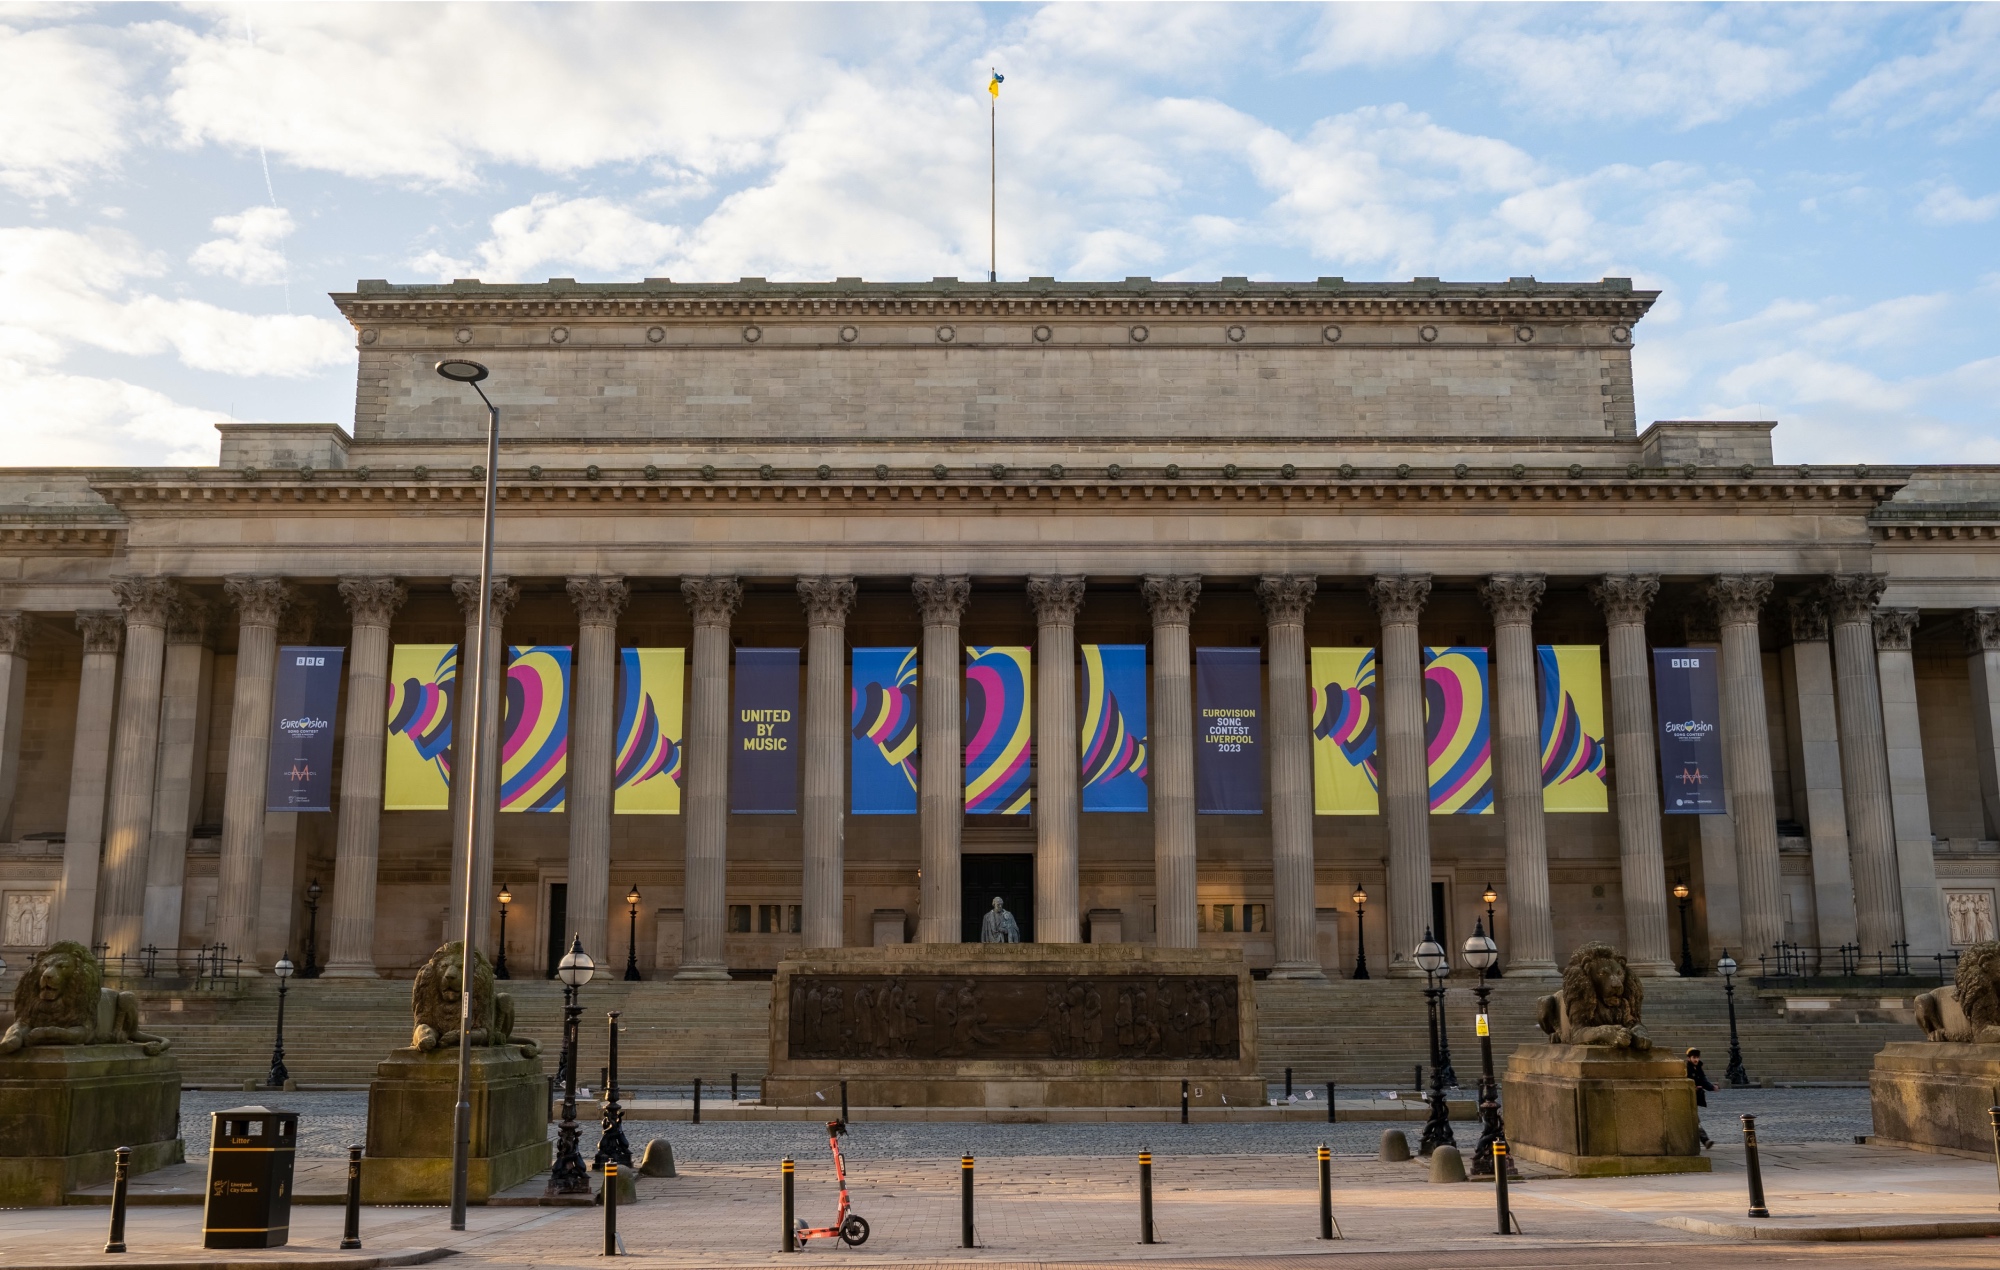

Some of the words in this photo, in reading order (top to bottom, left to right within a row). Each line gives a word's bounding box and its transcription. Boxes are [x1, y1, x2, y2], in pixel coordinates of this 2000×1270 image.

[741, 709, 790, 722] UNITED
[1202, 709, 1256, 717] EUROVISION
[1217, 718, 1242, 726] SONG
[756, 724, 774, 736] BY
[1210, 726, 1250, 734] CONTEST
[1206, 735, 1254, 744] LIVERPOOL
[744, 738, 788, 750] MUSIC
[1218, 744, 1241, 752] 2023
[893, 947, 904, 955] TO
[906, 947, 922, 955] THE
[926, 947, 942, 955] MEN
[946, 947, 956, 955] OF
[960, 947, 1006, 955] LIVERPOOL
[1008, 947, 1028, 955] WHO
[1052, 947, 1060, 955] IN
[1064, 947, 1080, 955] THE
[1083, 947, 1110, 955] GREAT
